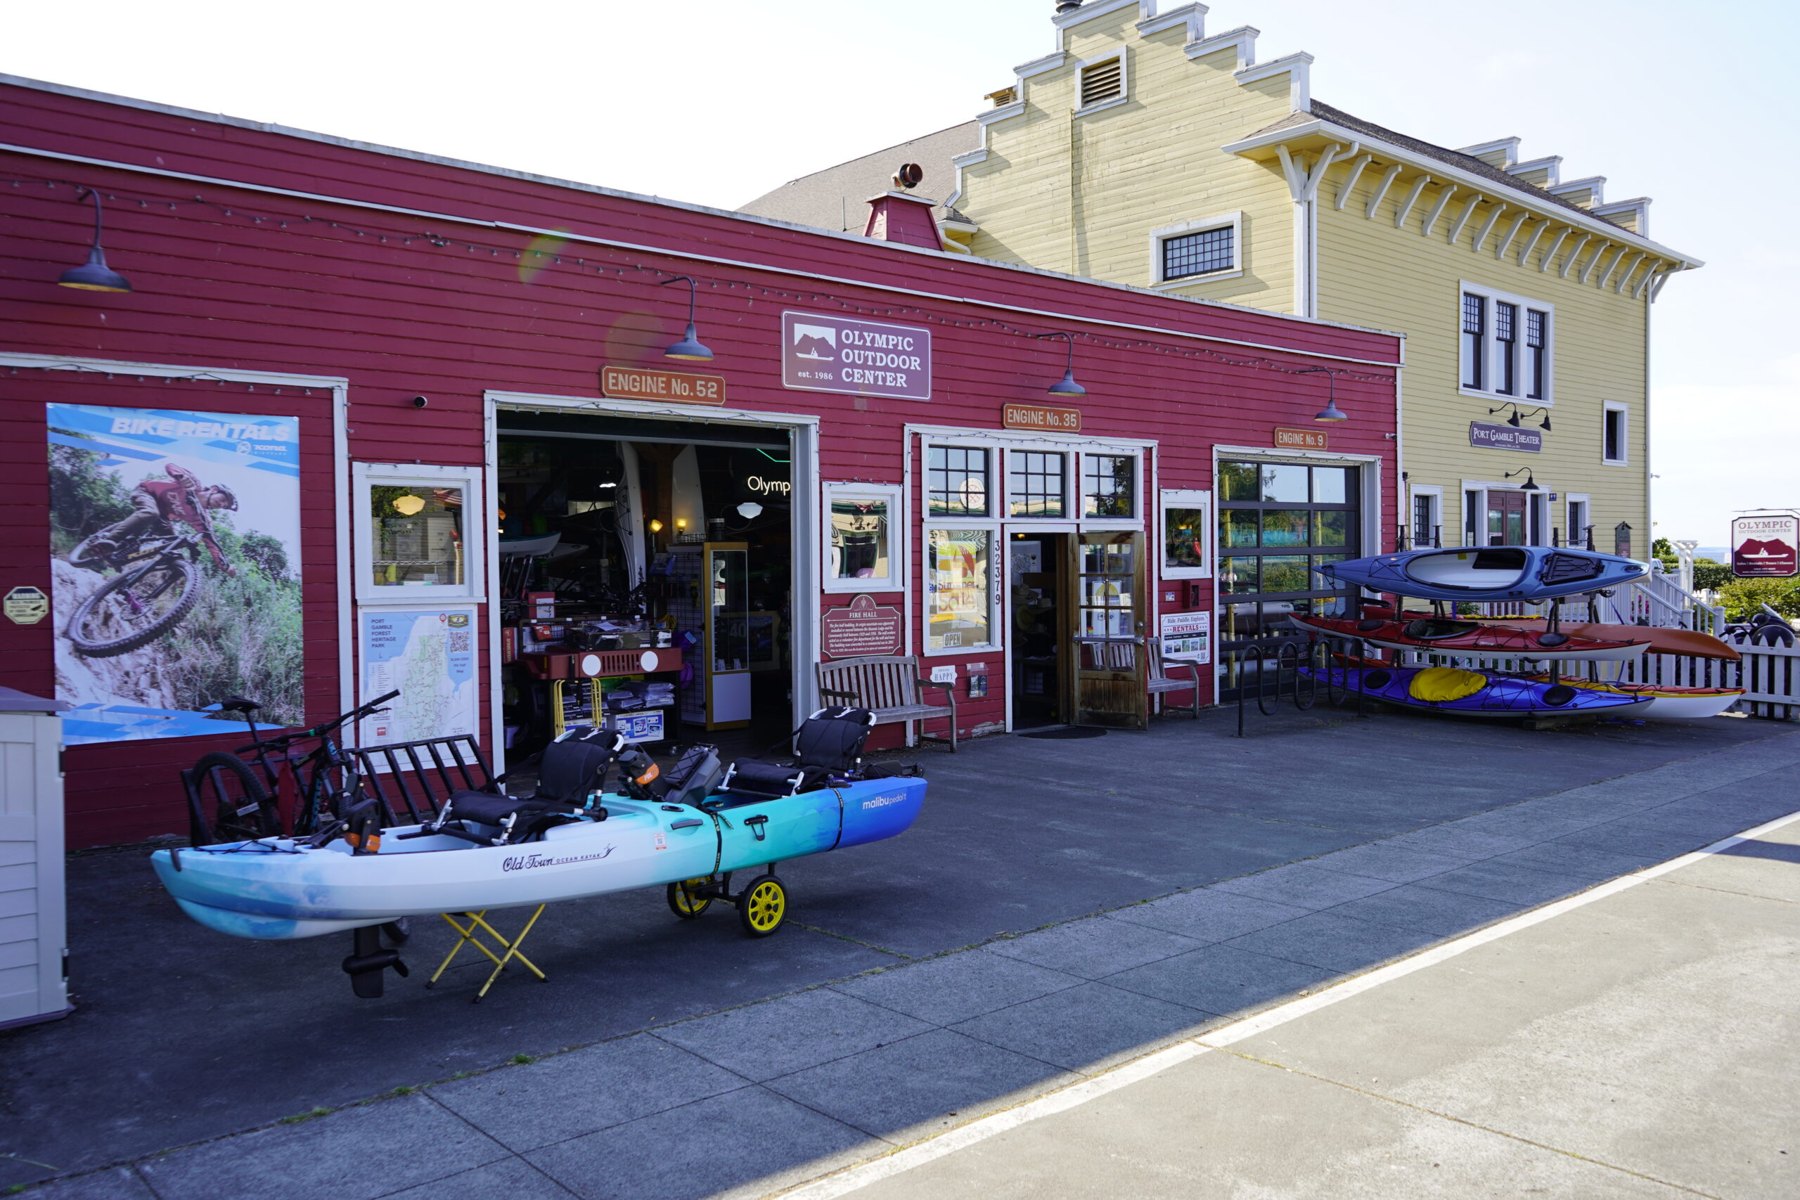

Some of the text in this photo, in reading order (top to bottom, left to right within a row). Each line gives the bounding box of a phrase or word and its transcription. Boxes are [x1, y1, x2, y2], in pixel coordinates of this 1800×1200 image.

[841, 329, 914, 351] OLYMPIC
[841, 348, 922, 371] OUTDOOR
[798, 371, 833, 380] est. 1986
[841, 367, 908, 388] CENTER
[608, 372, 718, 398] ENGINE No. 52
[1008, 409, 1077, 427] ENGINE No. 35
[110, 416, 291, 442] BIKE RENTALS
[1473, 428, 1490, 440] PORT
[1278, 432, 1324, 446] ENGINE No. 9
[1738, 520, 1792, 530] OLYMPIC
[945, 633, 961, 646] OPEN
[934, 672, 953, 681] HAPPY
[503, 856, 525, 872] Old
[525, 854, 553, 869] Town
